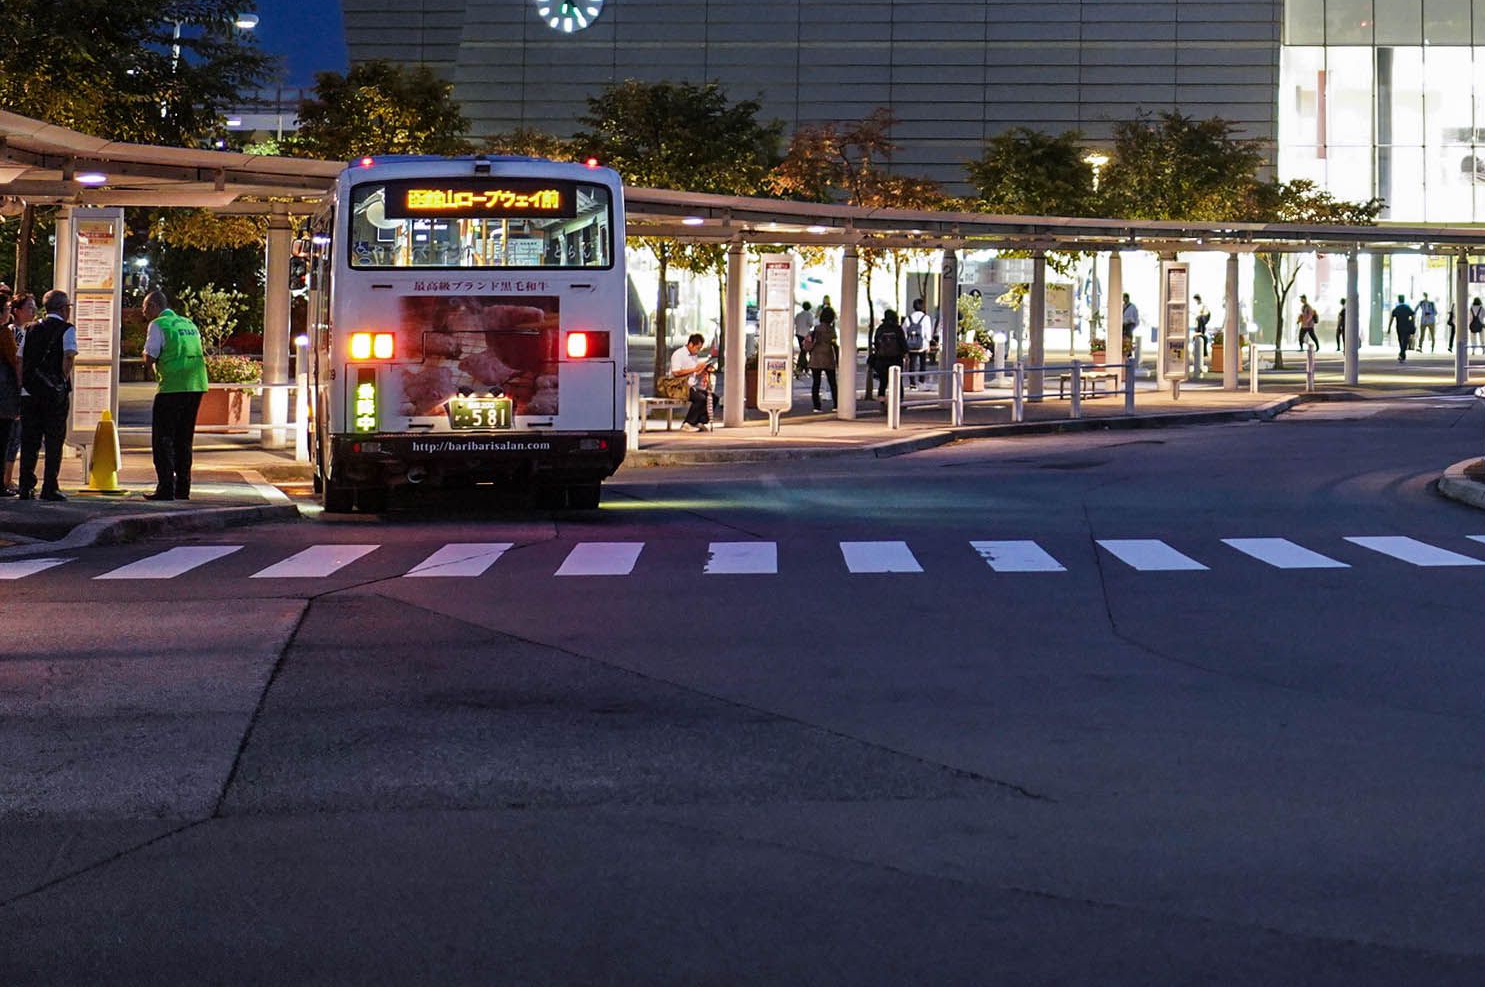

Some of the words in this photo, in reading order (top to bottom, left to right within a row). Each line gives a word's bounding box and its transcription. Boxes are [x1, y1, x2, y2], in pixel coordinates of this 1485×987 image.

[407, 189, 560, 209] 函館山ロープウェイ前
[943, 265, 953, 279] 2
[414, 279, 549, 292] 最高級ブランド黒毛和牛
[472, 408, 505, 426] 581
[413, 441, 550, 453] http://baribarisalan.com
